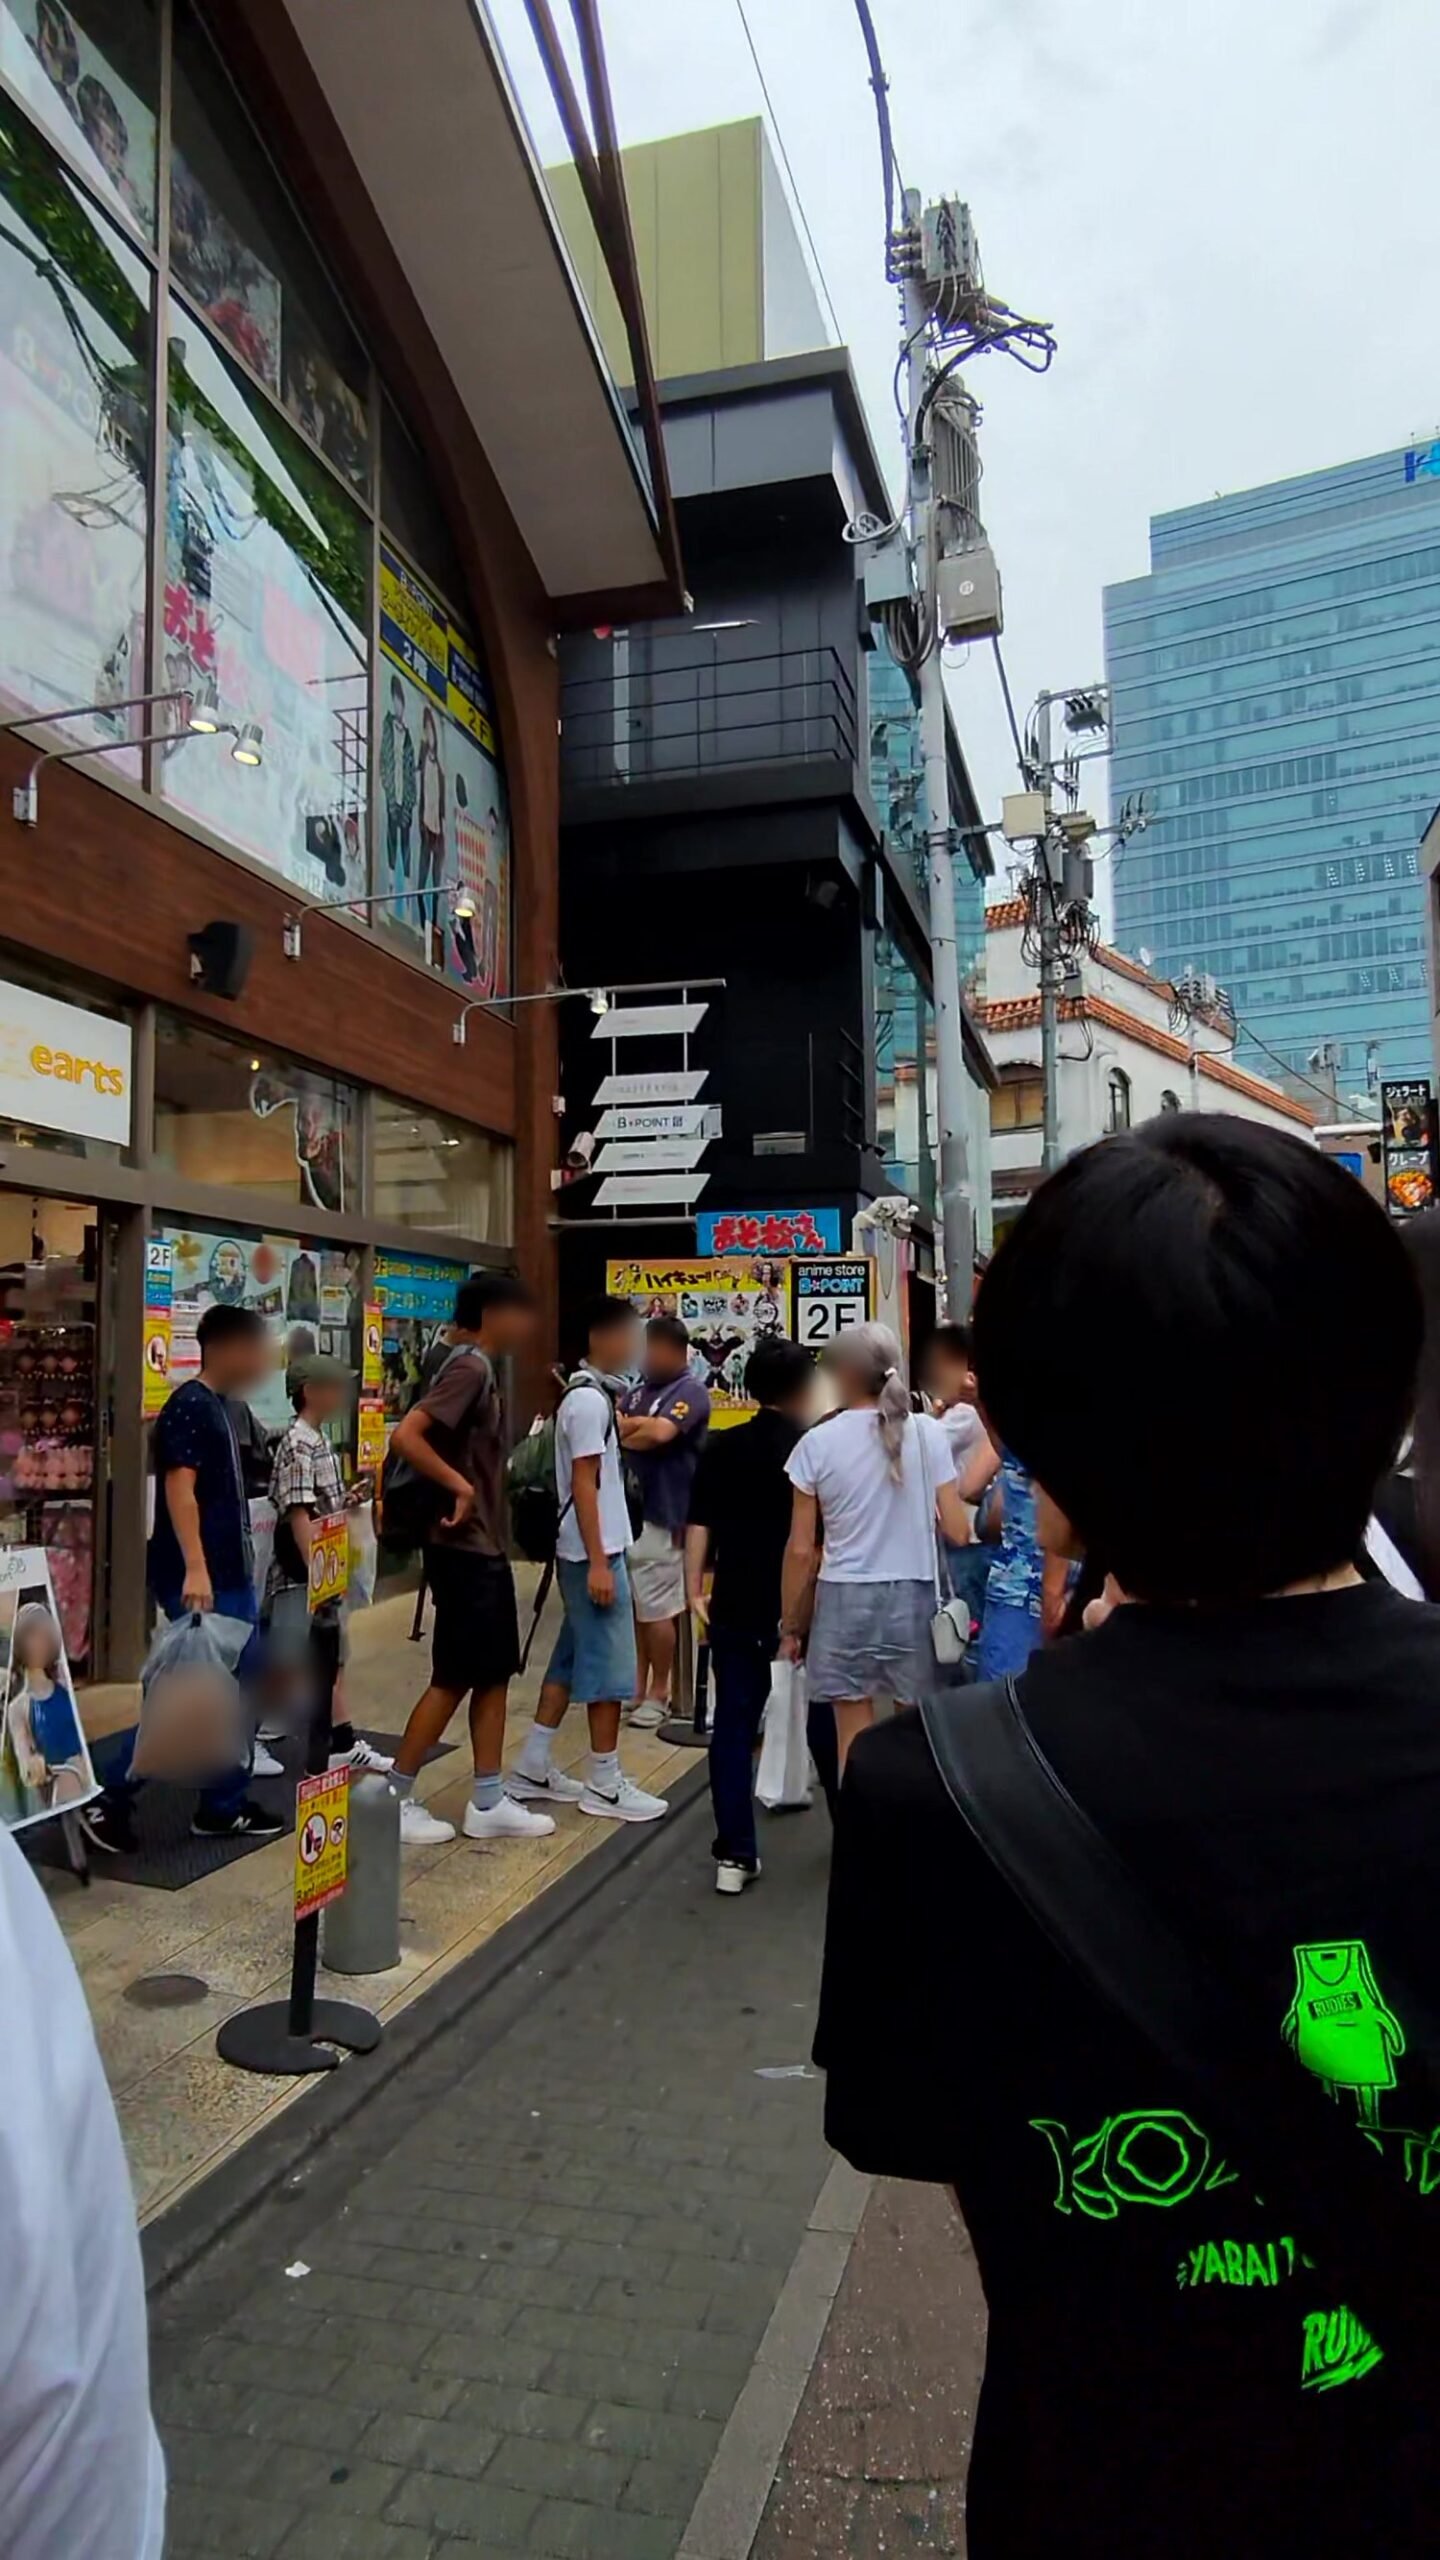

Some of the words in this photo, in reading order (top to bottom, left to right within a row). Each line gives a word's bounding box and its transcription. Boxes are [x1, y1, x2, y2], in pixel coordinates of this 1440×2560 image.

[1386, 1084, 1426, 1098] ジェラート
[1388, 1150, 1428, 1166] クレープ
[713, 1213, 825, 1252] おそ松さん
[150, 1247, 171, 1267] 2F
[798, 1264, 833, 1276] anime
[834, 1265, 865, 1276] store
[807, 1304, 857, 1340] 2F
[1313, 1992, 1357, 2017] RUDIES
